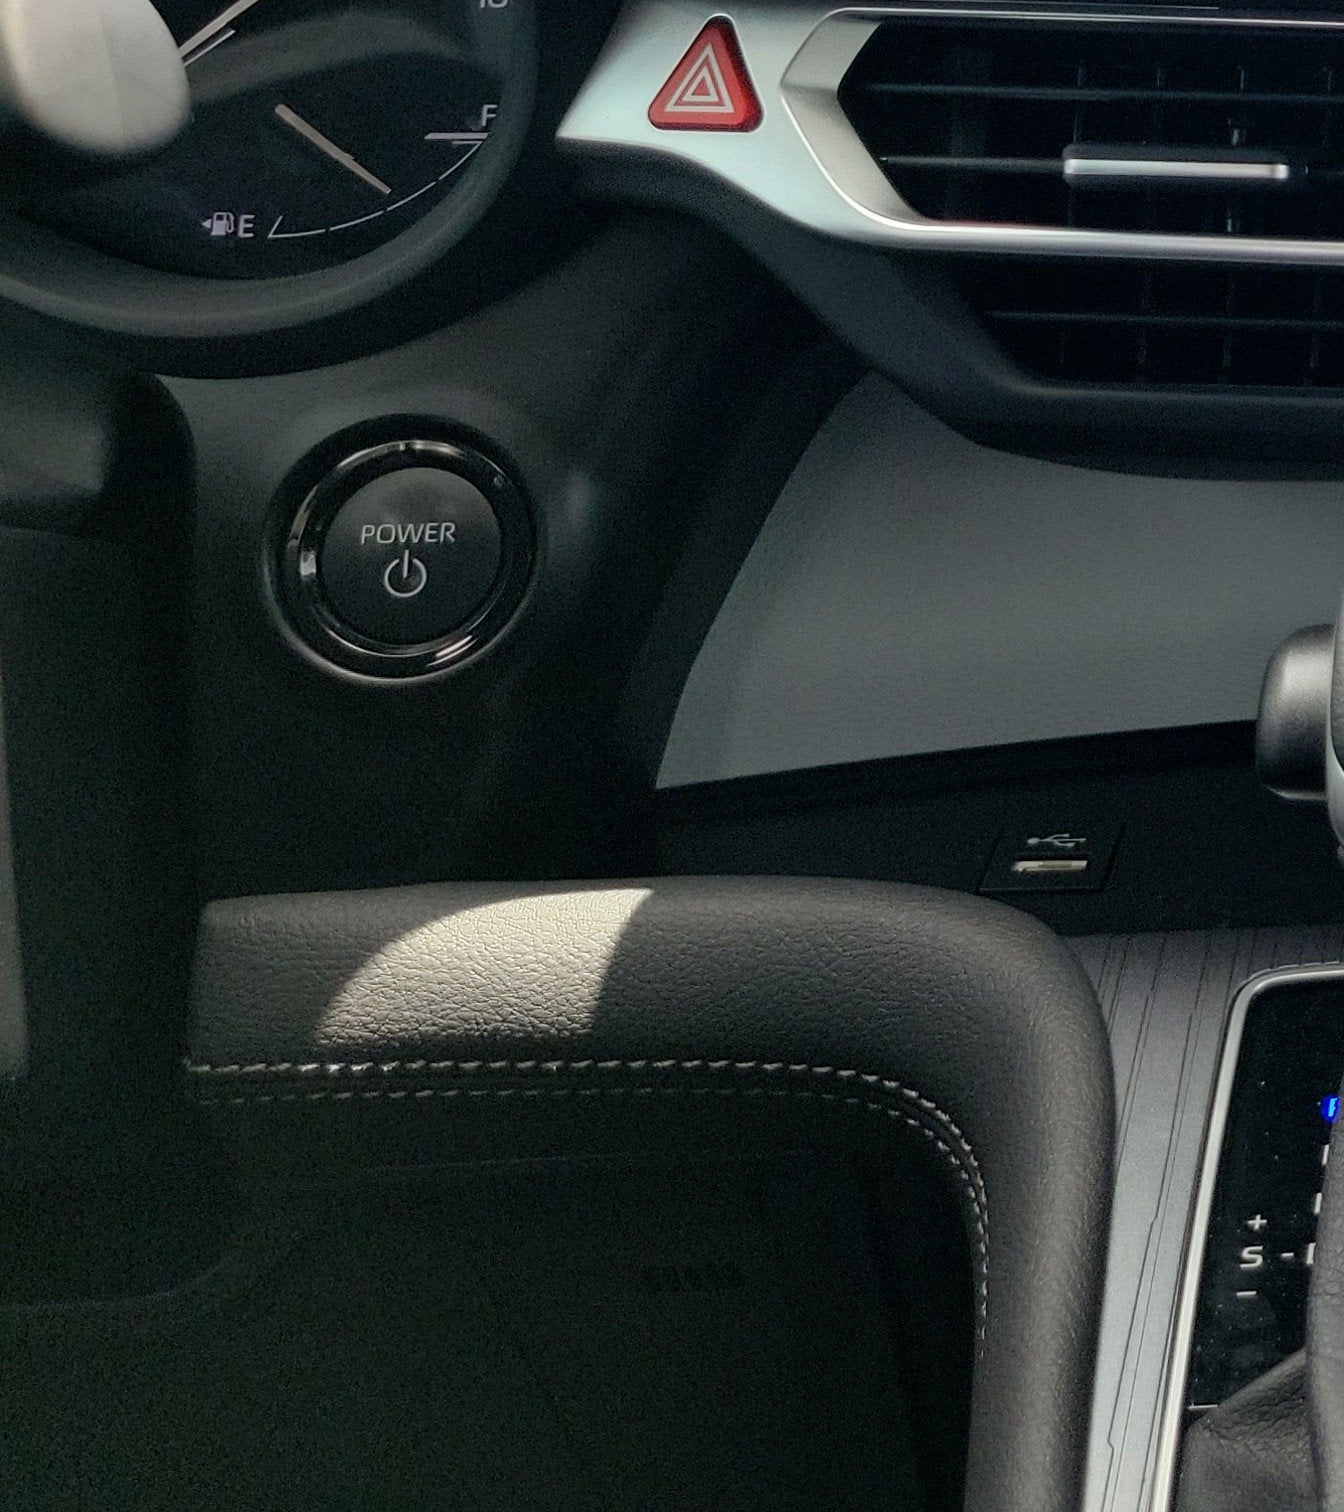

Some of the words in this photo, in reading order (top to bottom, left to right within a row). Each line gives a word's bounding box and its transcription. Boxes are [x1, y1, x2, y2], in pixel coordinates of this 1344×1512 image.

[481, 104, 498, 126] F
[238, 215, 254, 237] E
[361, 522, 456, 545] POWER
[1239, 1246, 1264, 1269] S
